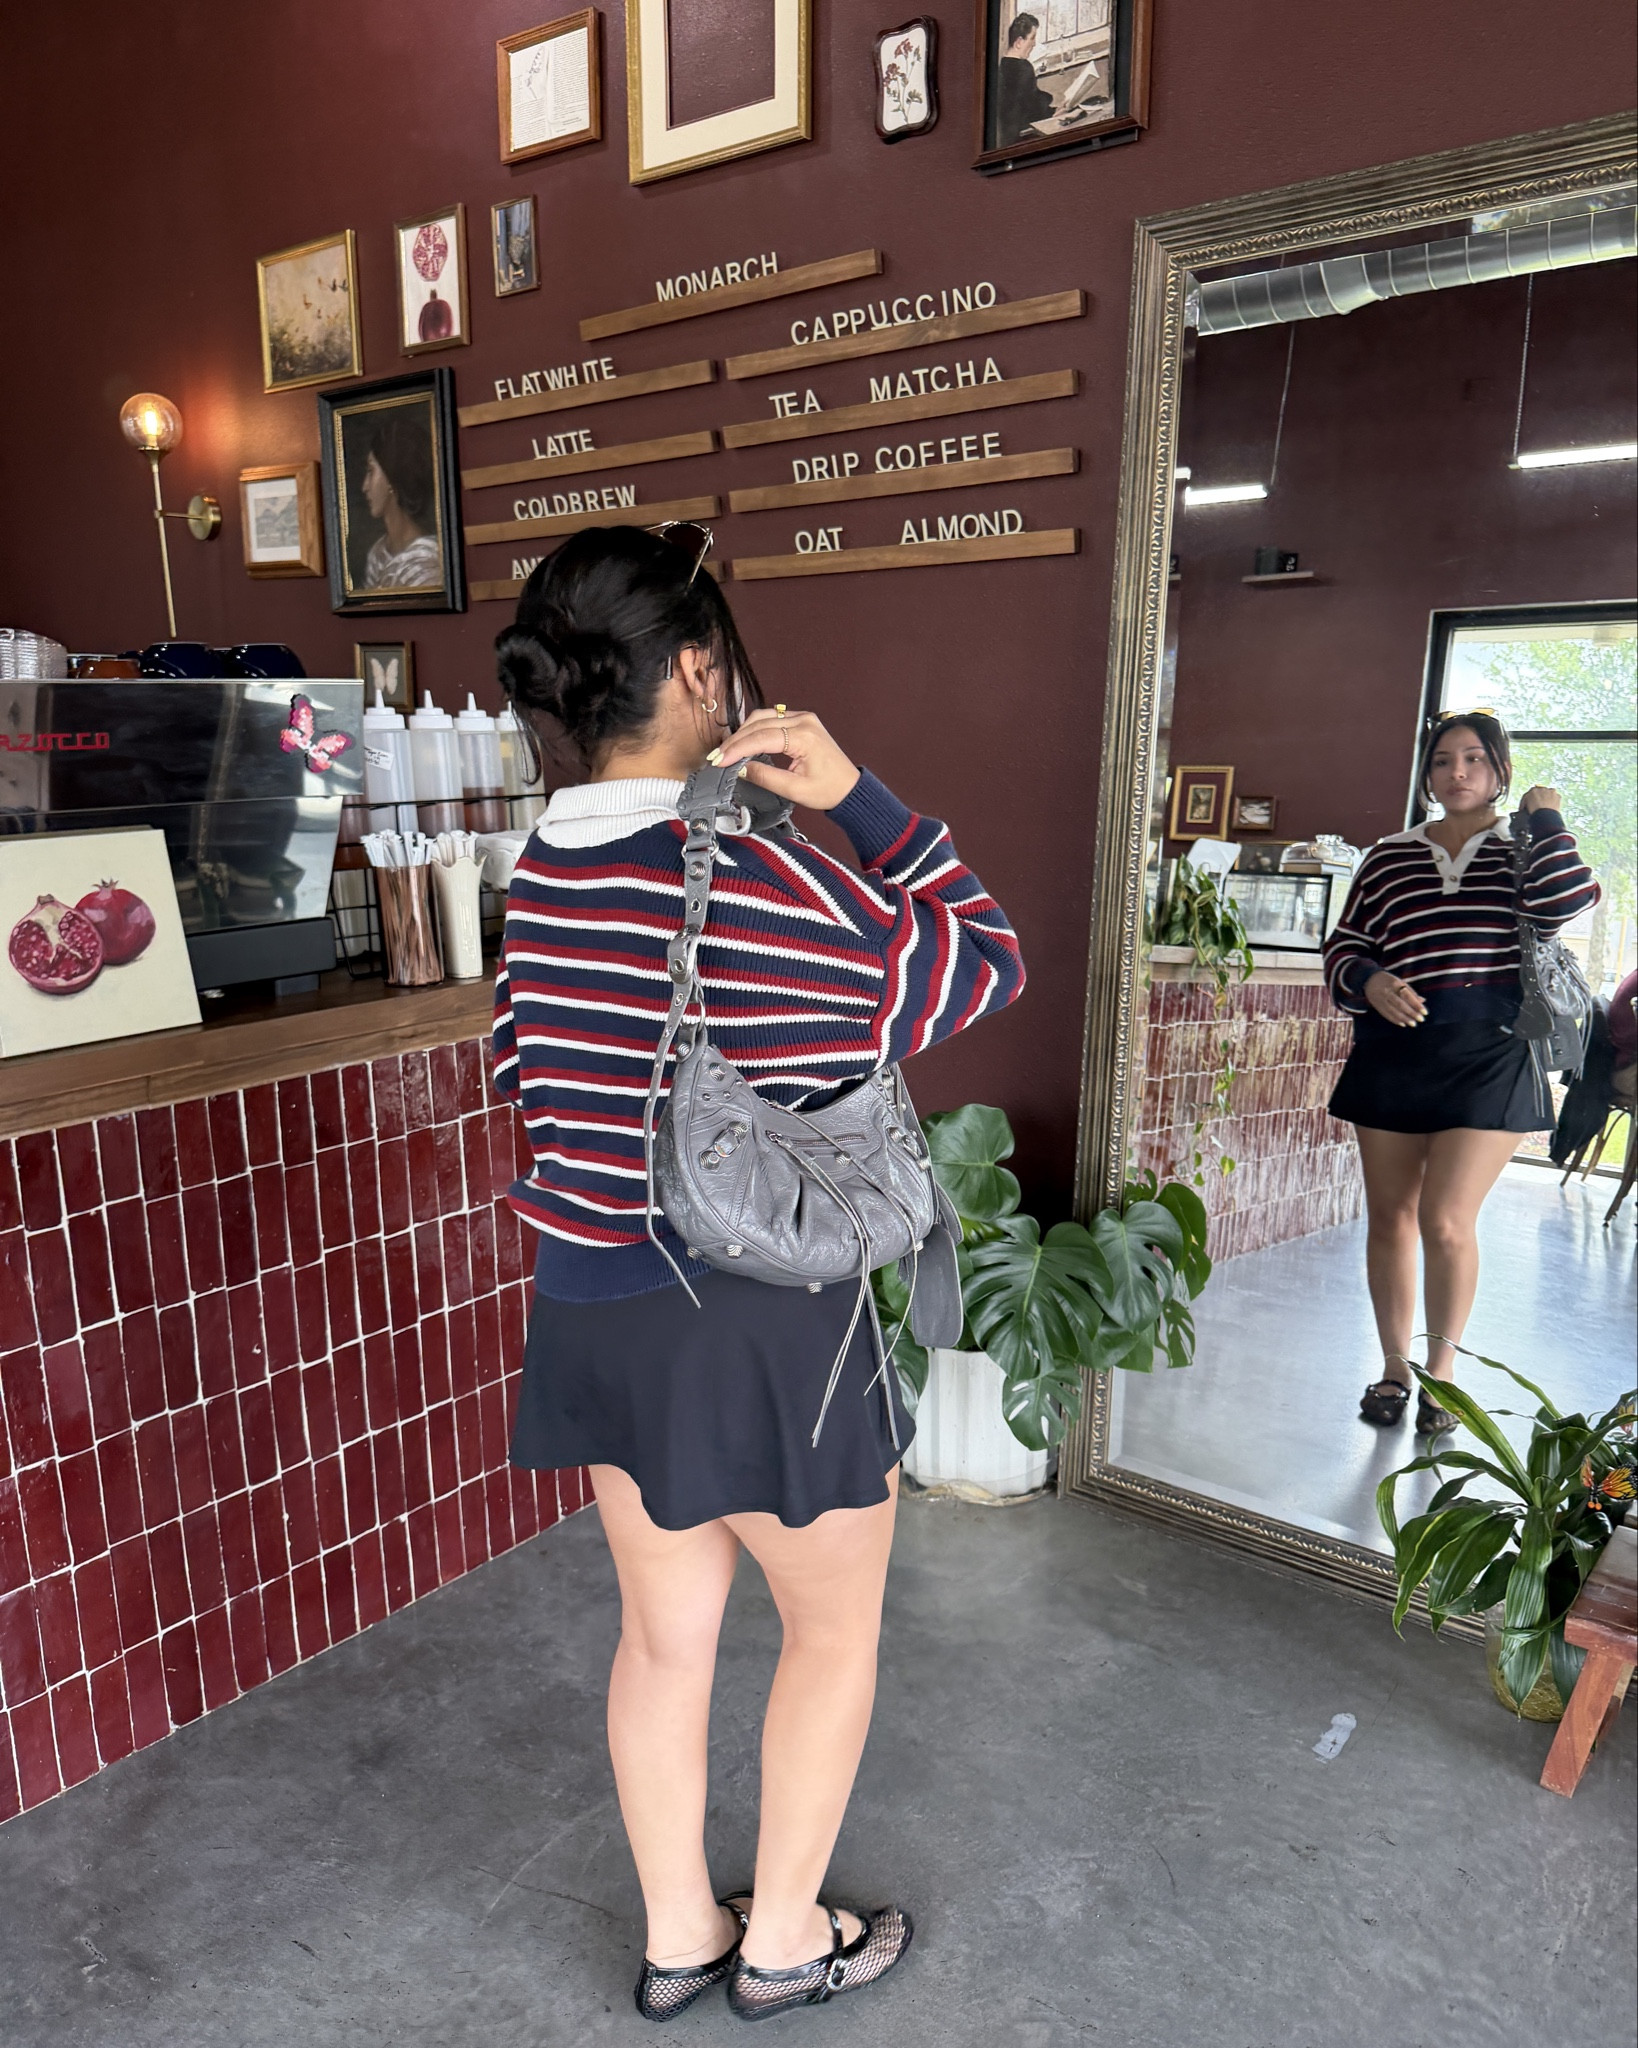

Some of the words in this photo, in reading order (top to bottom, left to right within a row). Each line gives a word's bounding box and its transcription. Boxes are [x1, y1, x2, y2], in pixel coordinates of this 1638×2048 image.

[655, 251, 778, 303] MONARCH
[790, 281, 997, 346] CAPPUCCINO
[768, 389, 823, 419] TEA
[869, 357, 1004, 404] MATCHA
[531, 429, 595, 461] LATTE
[792, 452, 860, 485] DRIP
[875, 432, 1003, 474] COFFEE
[795, 526, 843, 555] OAT
[899, 509, 1026, 546] ALMOND
